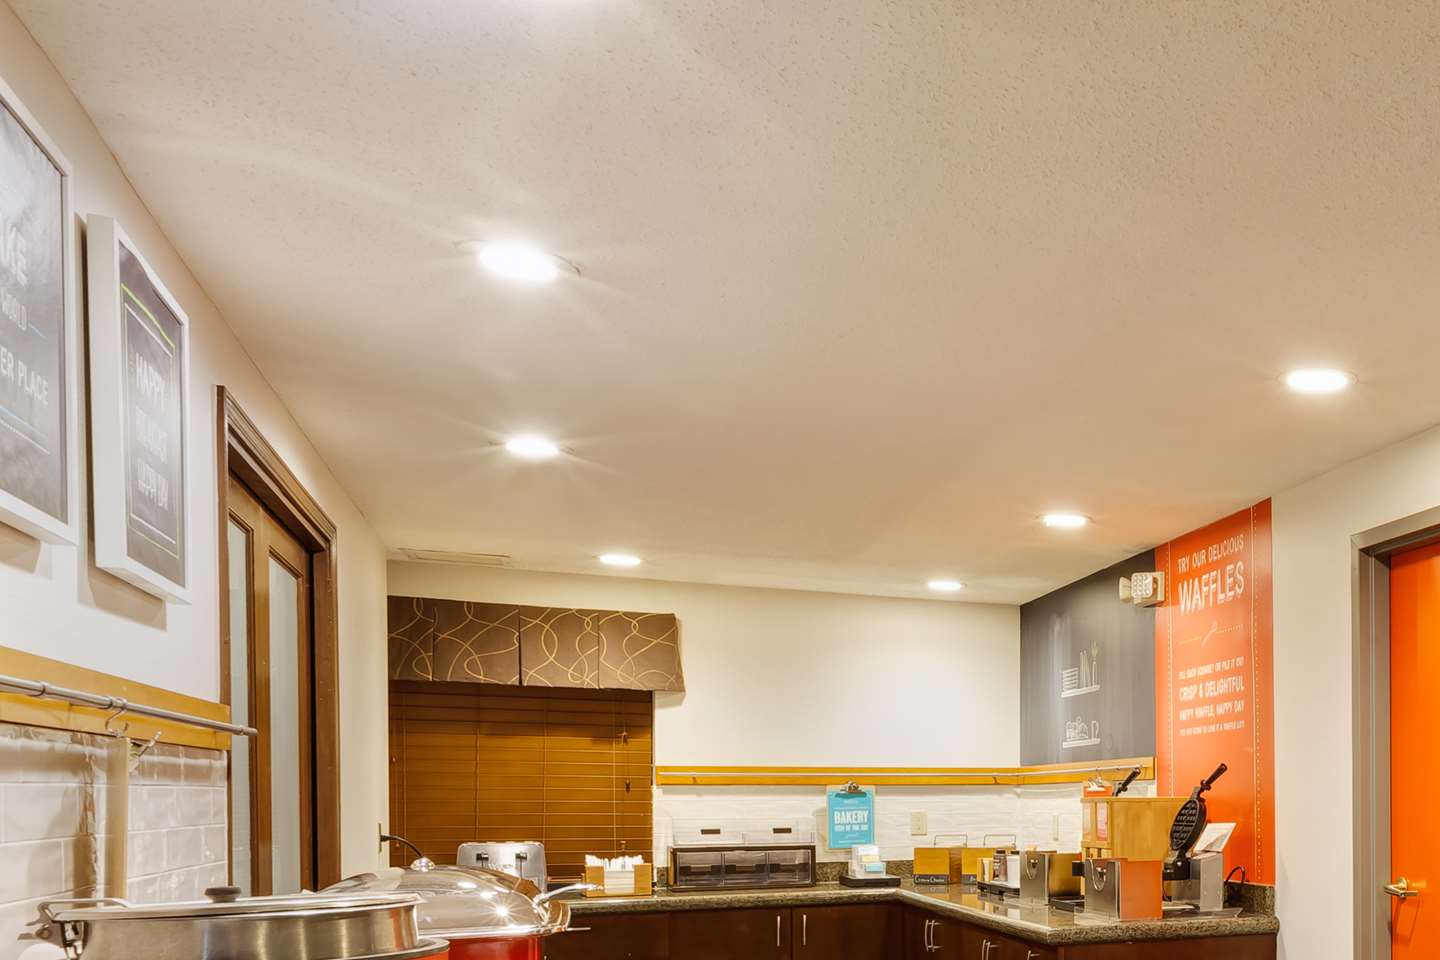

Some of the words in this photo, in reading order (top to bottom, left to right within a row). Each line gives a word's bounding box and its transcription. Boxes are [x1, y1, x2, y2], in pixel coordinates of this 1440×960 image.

[18, 360, 48, 406] PLACE
[1178, 554, 1190, 575] TRY
[1192, 549, 1206, 568] OUR
[1208, 534, 1244, 563] DELICIOUS
[1178, 560, 1244, 615] WAFFLES
[1179, 684, 1197, 703] CRISP
[1205, 675, 1245, 698] DELIGHTFUL
[834, 810, 869, 825] BAKERY
